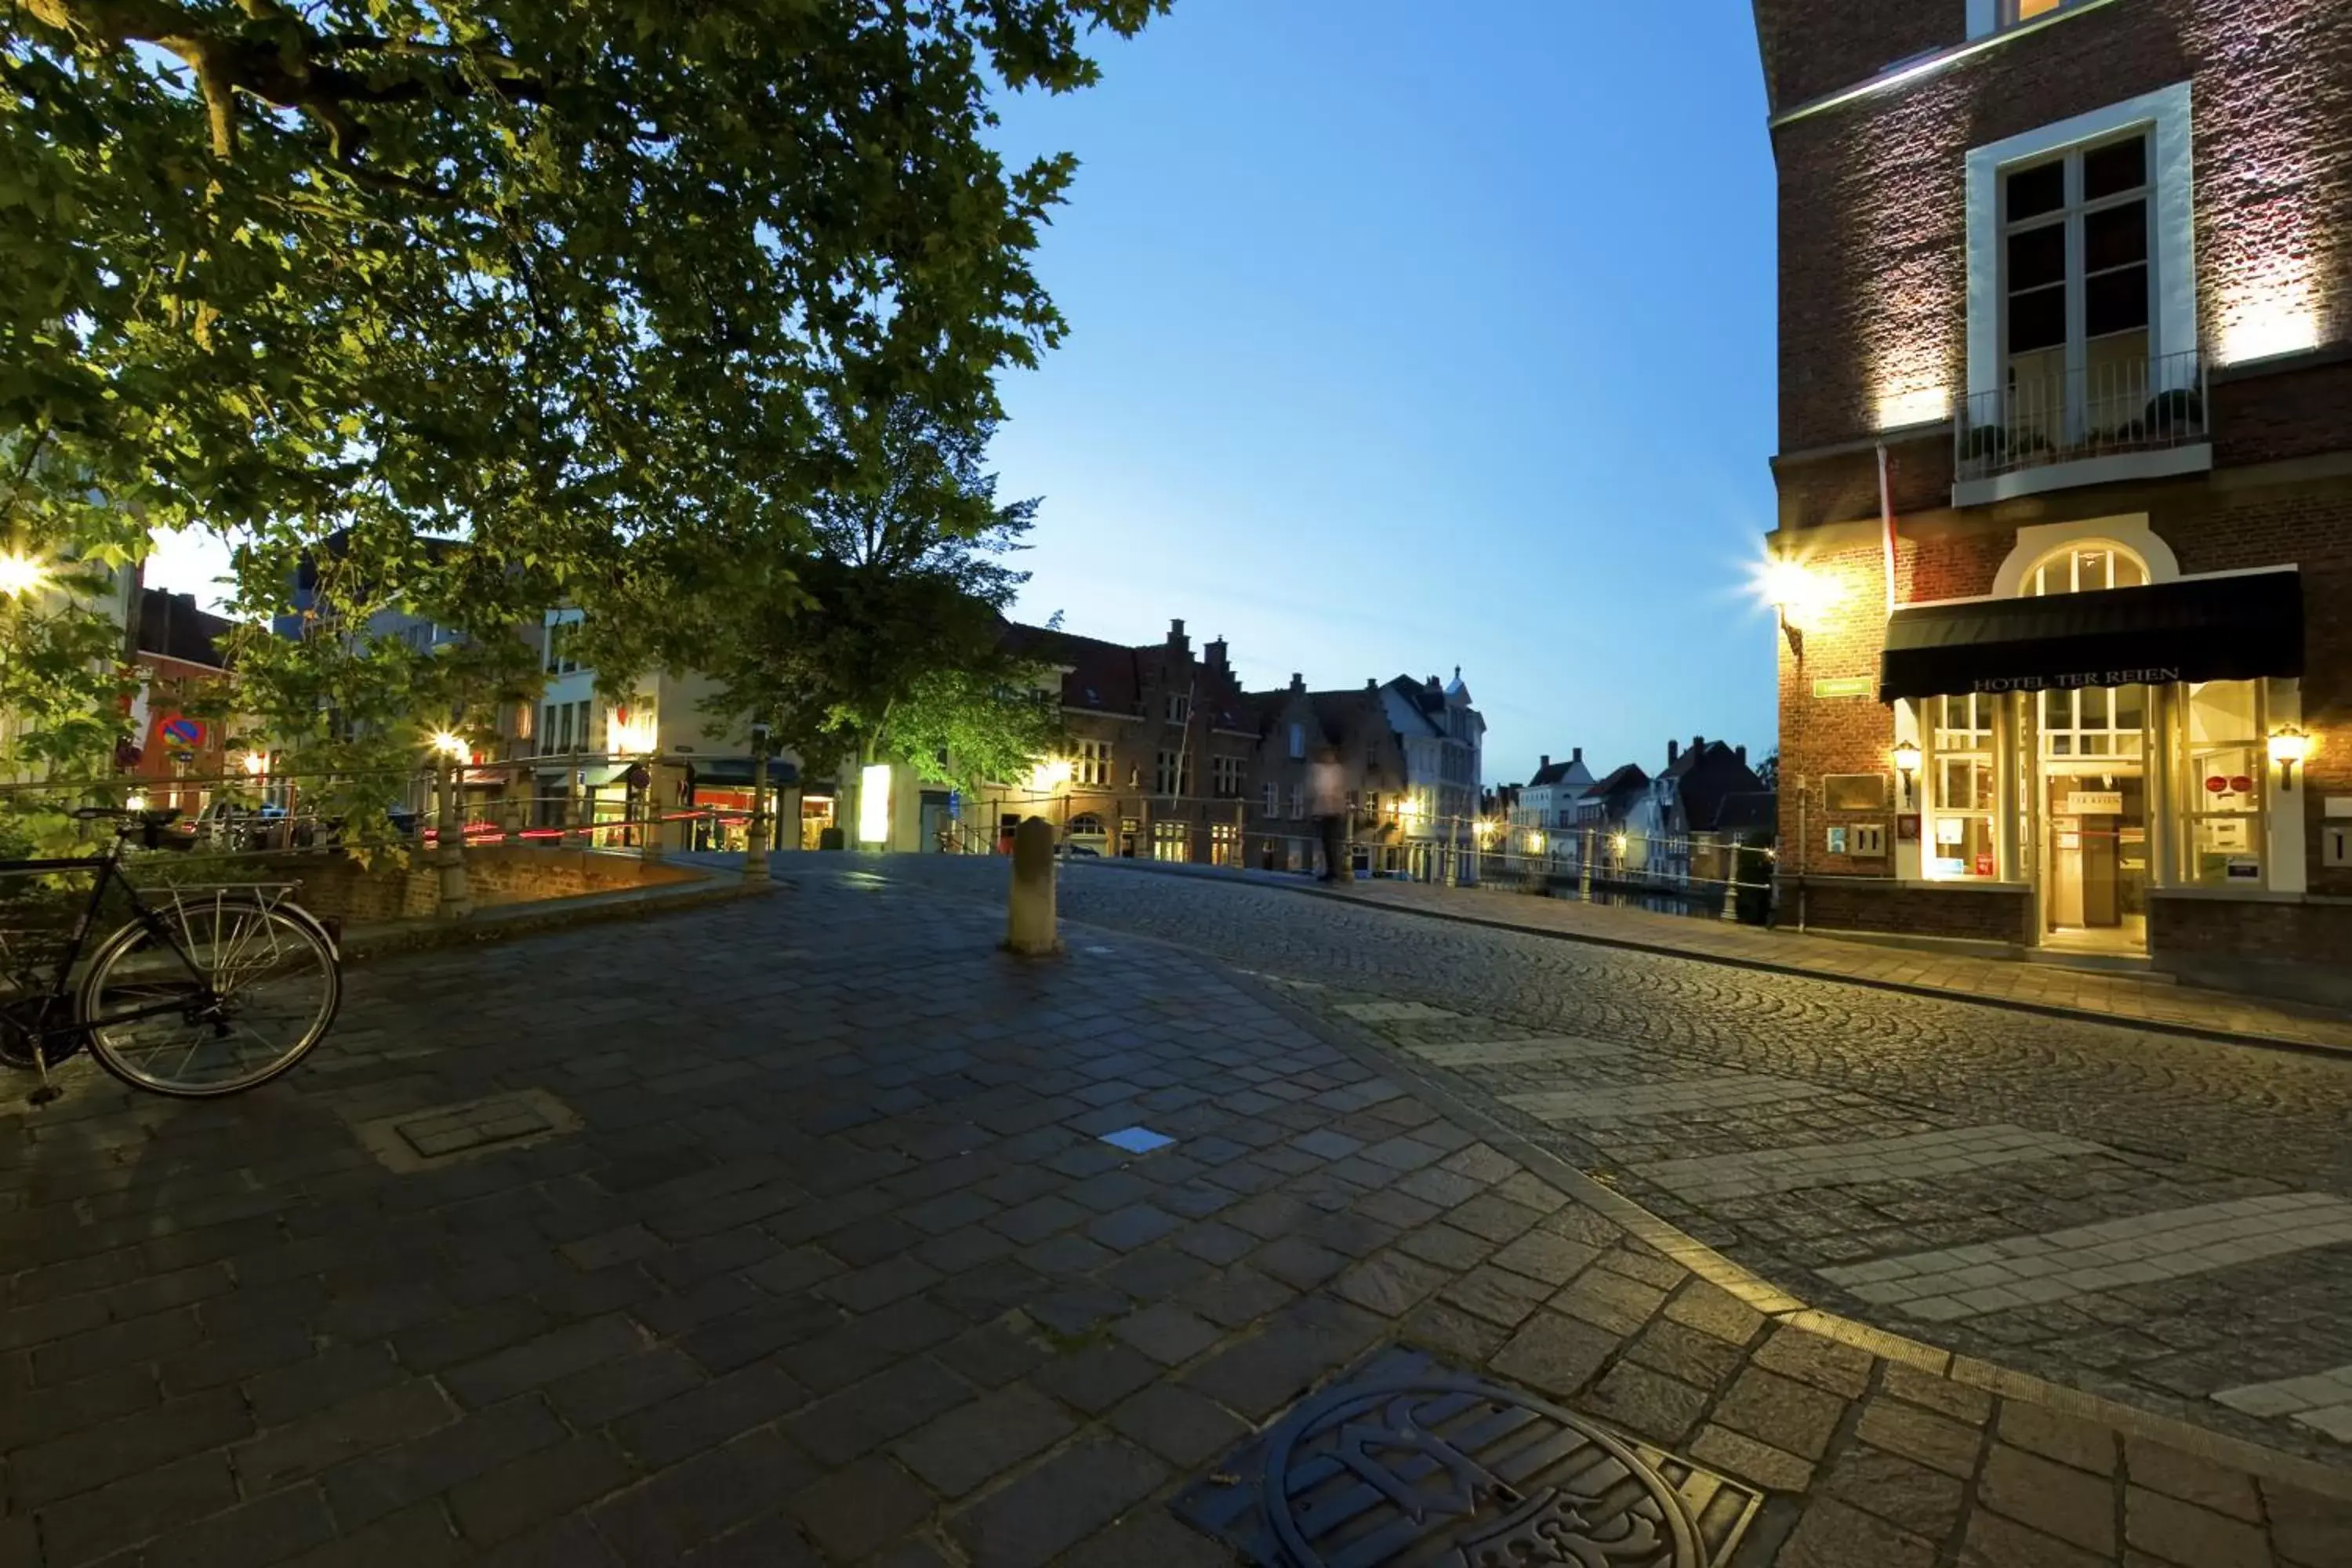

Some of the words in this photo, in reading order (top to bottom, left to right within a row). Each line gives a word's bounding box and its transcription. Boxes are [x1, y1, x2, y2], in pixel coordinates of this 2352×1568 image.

[1973, 677, 2049, 691] HOTEL
[2056, 672, 2098, 688] TER
[2105, 667, 2180, 684] REIEN
